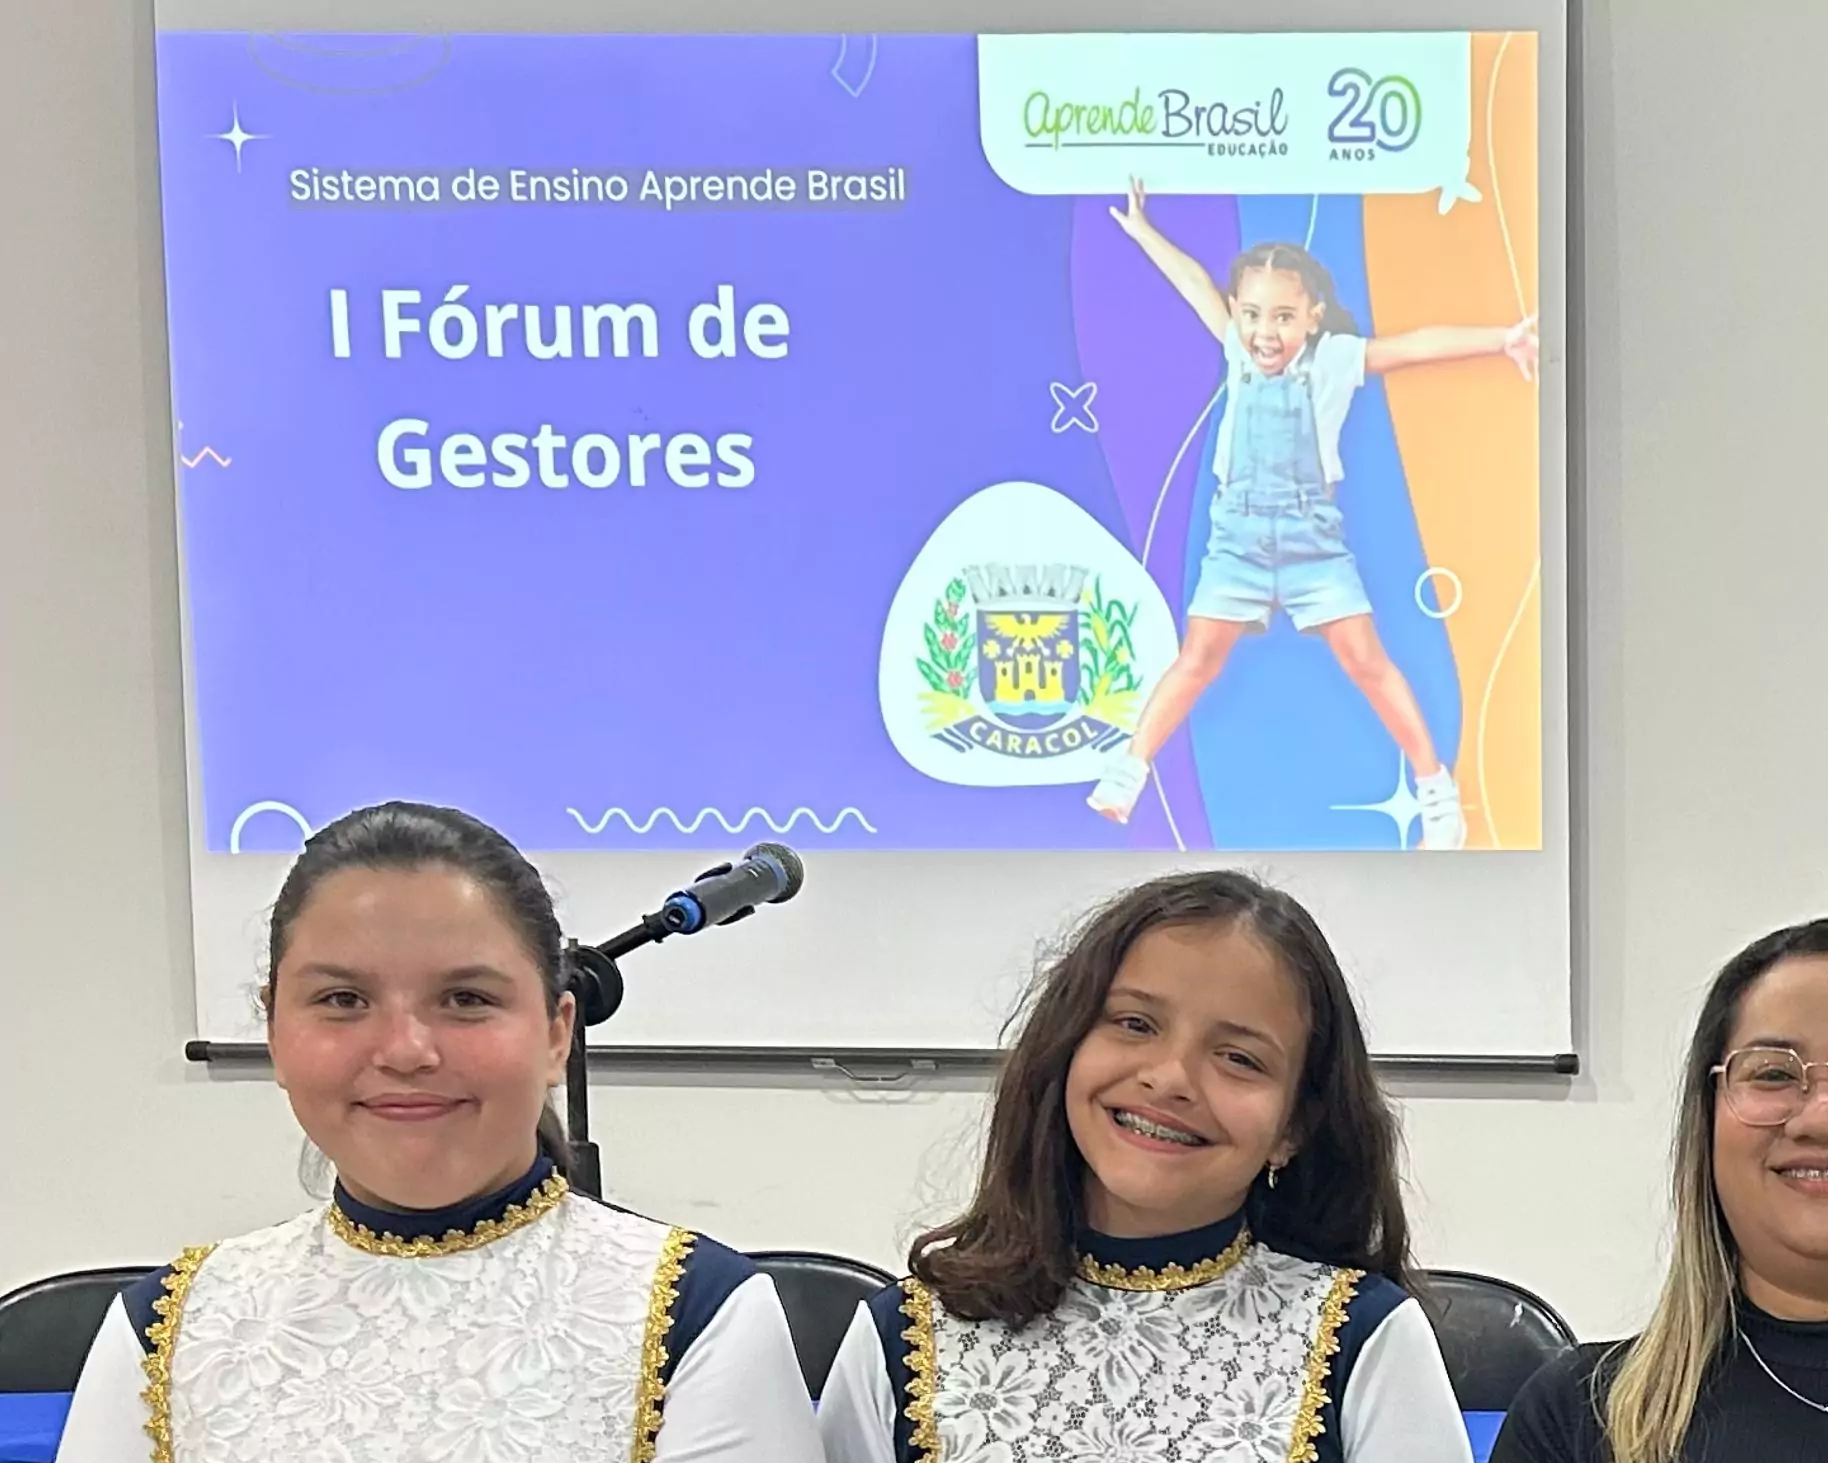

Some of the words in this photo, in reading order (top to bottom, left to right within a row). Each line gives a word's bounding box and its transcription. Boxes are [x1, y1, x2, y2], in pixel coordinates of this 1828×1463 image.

[1327, 67, 1422, 154] 20
[1207, 139, 1289, 159] EDUCAÇÃO
[1328, 148, 1376, 162] ANOS
[290, 168, 440, 202] Sistema
[451, 168, 499, 202] de
[510, 169, 629, 202] Ensino
[639, 167, 796, 210] Aprende
[808, 168, 906, 202] Brasil
[329, 289, 352, 359] I
[381, 284, 659, 361] Fórum
[688, 285, 791, 361] de
[376, 418, 757, 490] Gestores
[969, 721, 1099, 755] CARACOL
